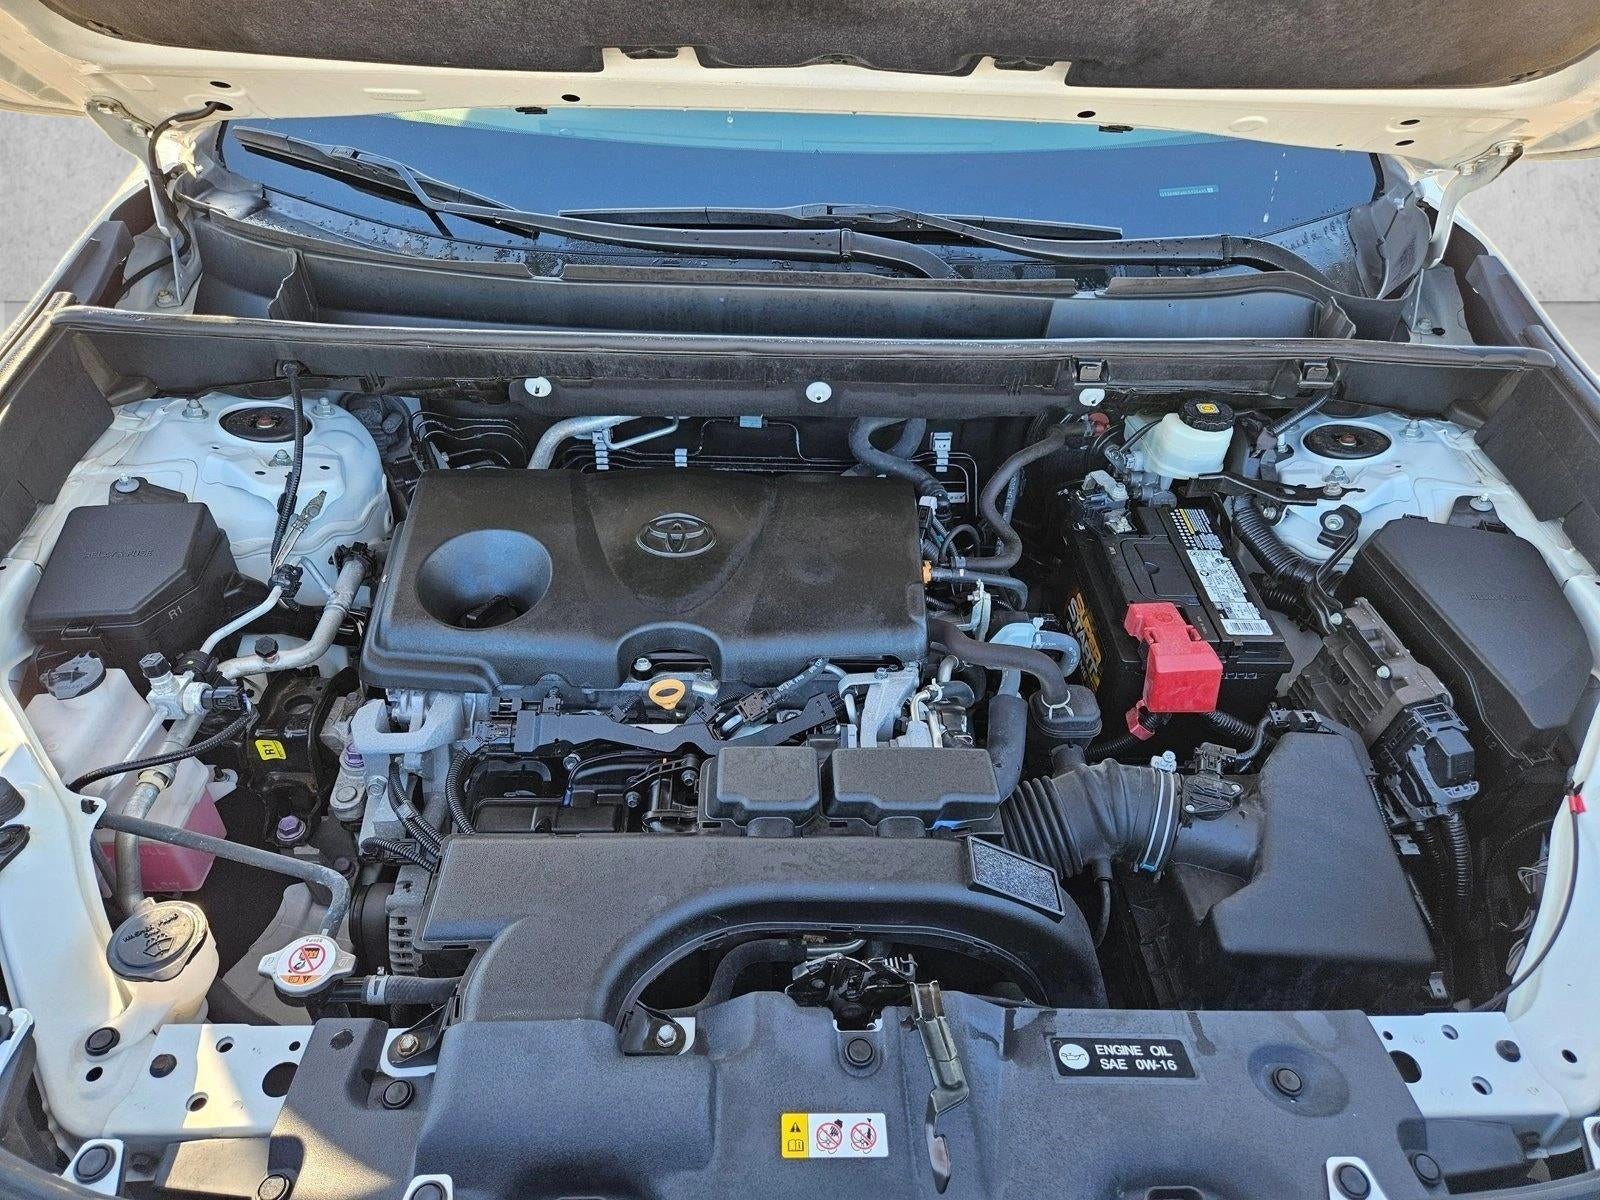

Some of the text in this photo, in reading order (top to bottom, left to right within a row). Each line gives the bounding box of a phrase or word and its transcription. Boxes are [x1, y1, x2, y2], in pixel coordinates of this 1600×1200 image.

[168, 605, 183, 620] R1
[1067, 596, 1098, 674] START
[263, 744, 276, 756] R1
[1094, 1044, 1173, 1057] ENGINE OIL
[1099, 1058, 1129, 1070] SAE
